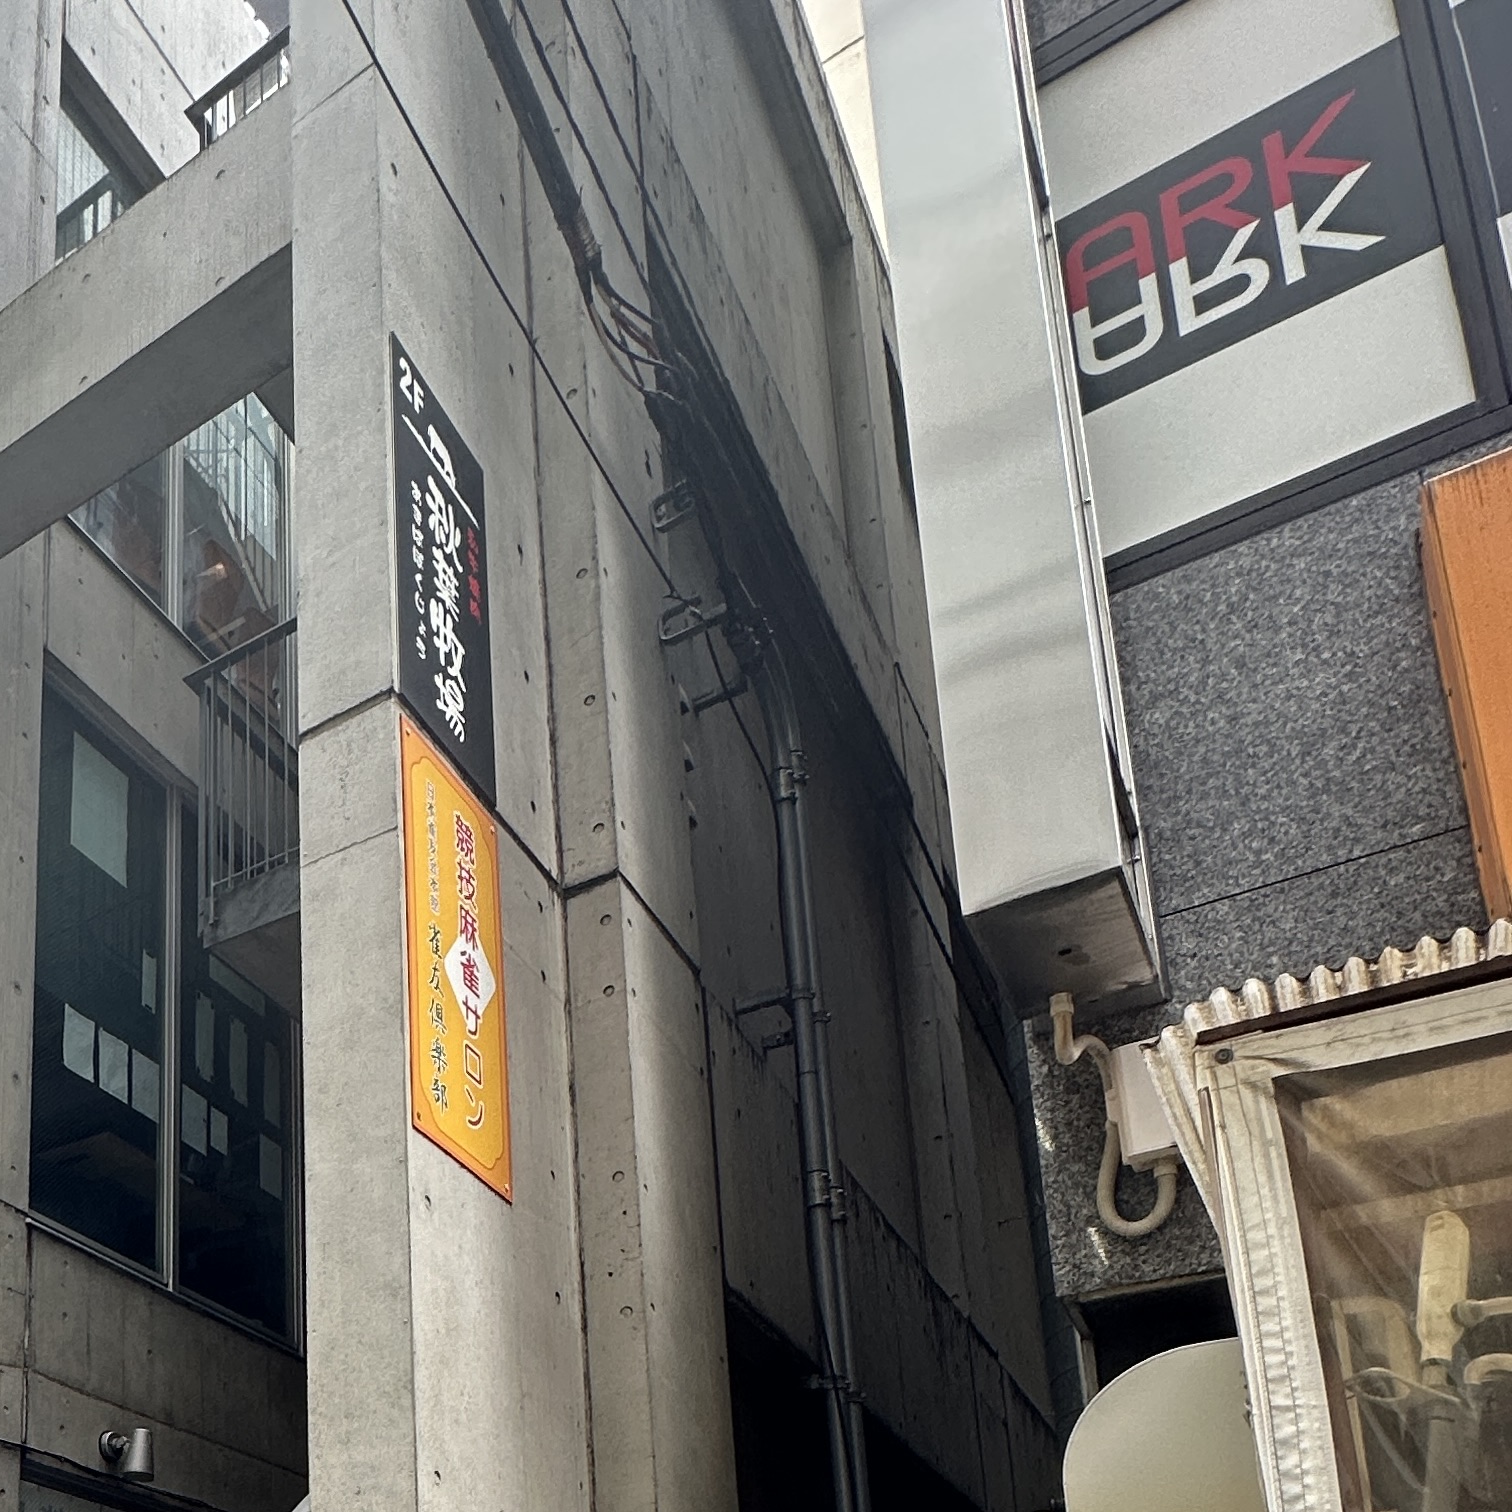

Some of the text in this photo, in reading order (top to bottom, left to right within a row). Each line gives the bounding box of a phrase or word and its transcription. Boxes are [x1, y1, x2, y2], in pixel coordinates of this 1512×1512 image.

[1066, 88, 1370, 313] ARK
[399, 356, 425, 415] 2F
[426, 474, 466, 744] 秋葉牧場
[428, 919, 449, 1116] 雀友倶楽部
[454, 813, 486, 1130] 競技麻雀サロン
